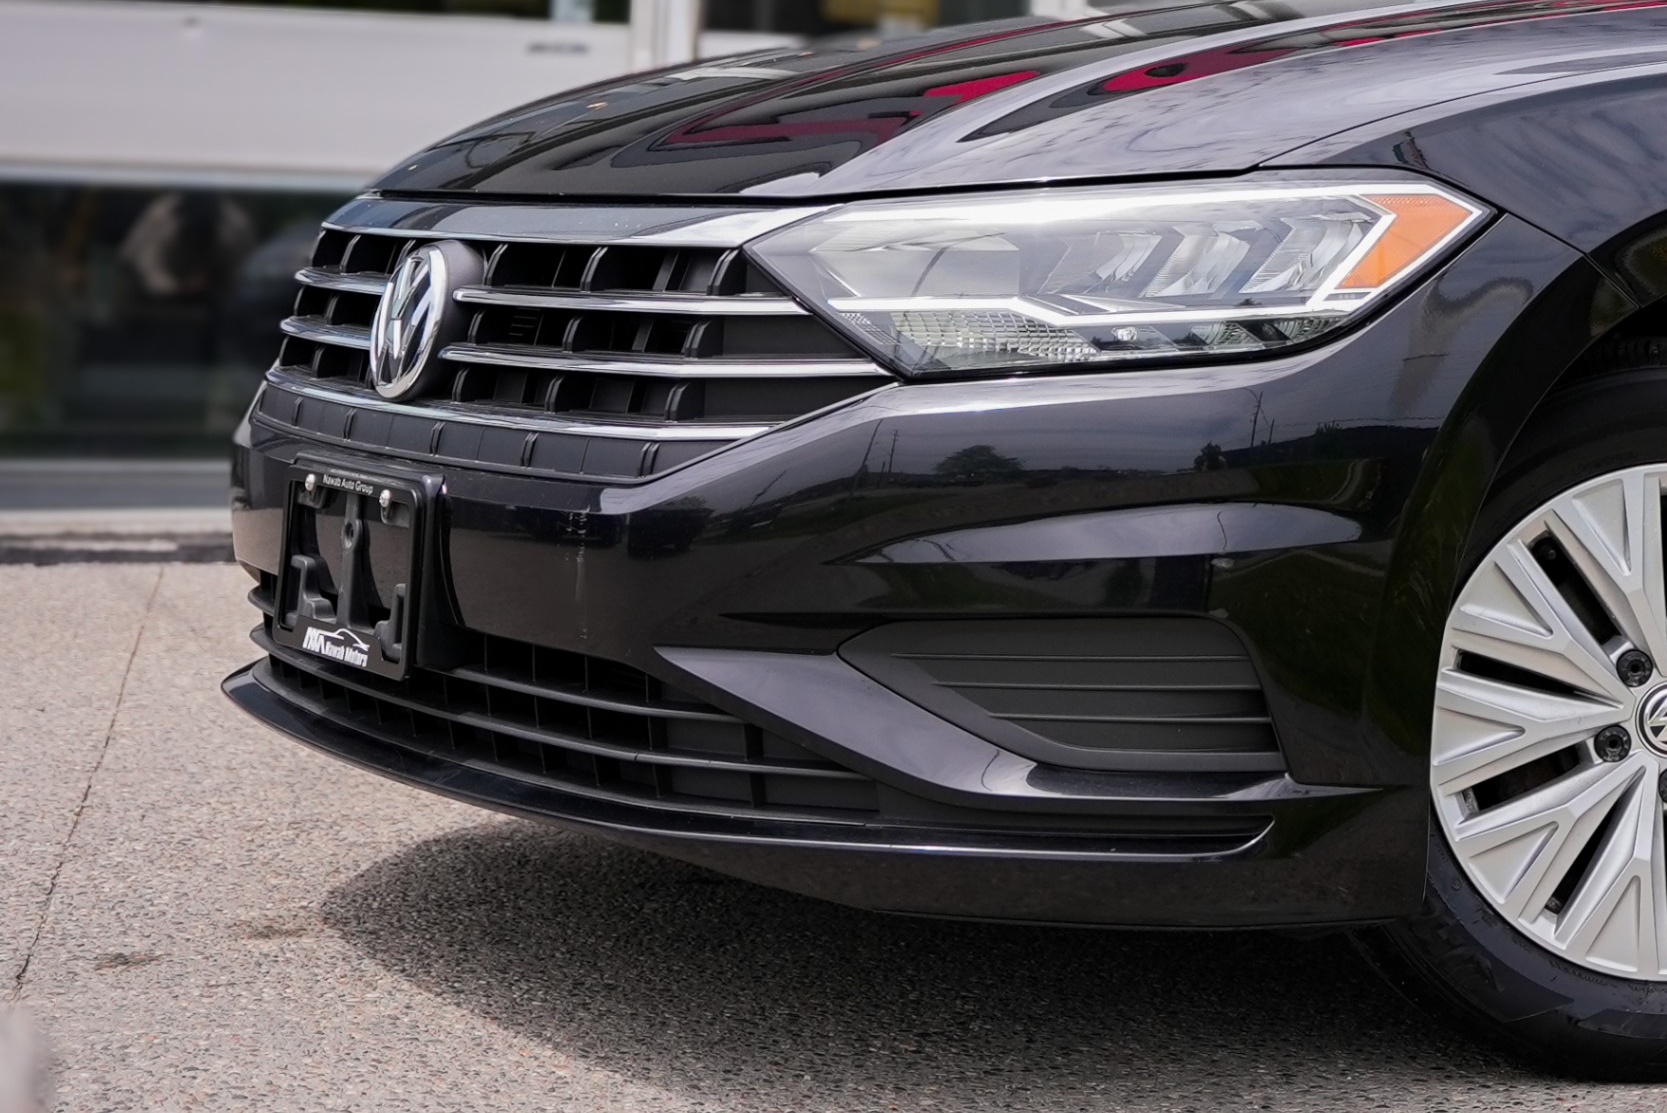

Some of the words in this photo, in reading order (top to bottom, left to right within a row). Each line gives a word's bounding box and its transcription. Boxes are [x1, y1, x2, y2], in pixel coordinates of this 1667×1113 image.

[322, 473, 341, 488] Nawab
[341, 477, 355, 491] Auto
[355, 480, 374, 496] Group
